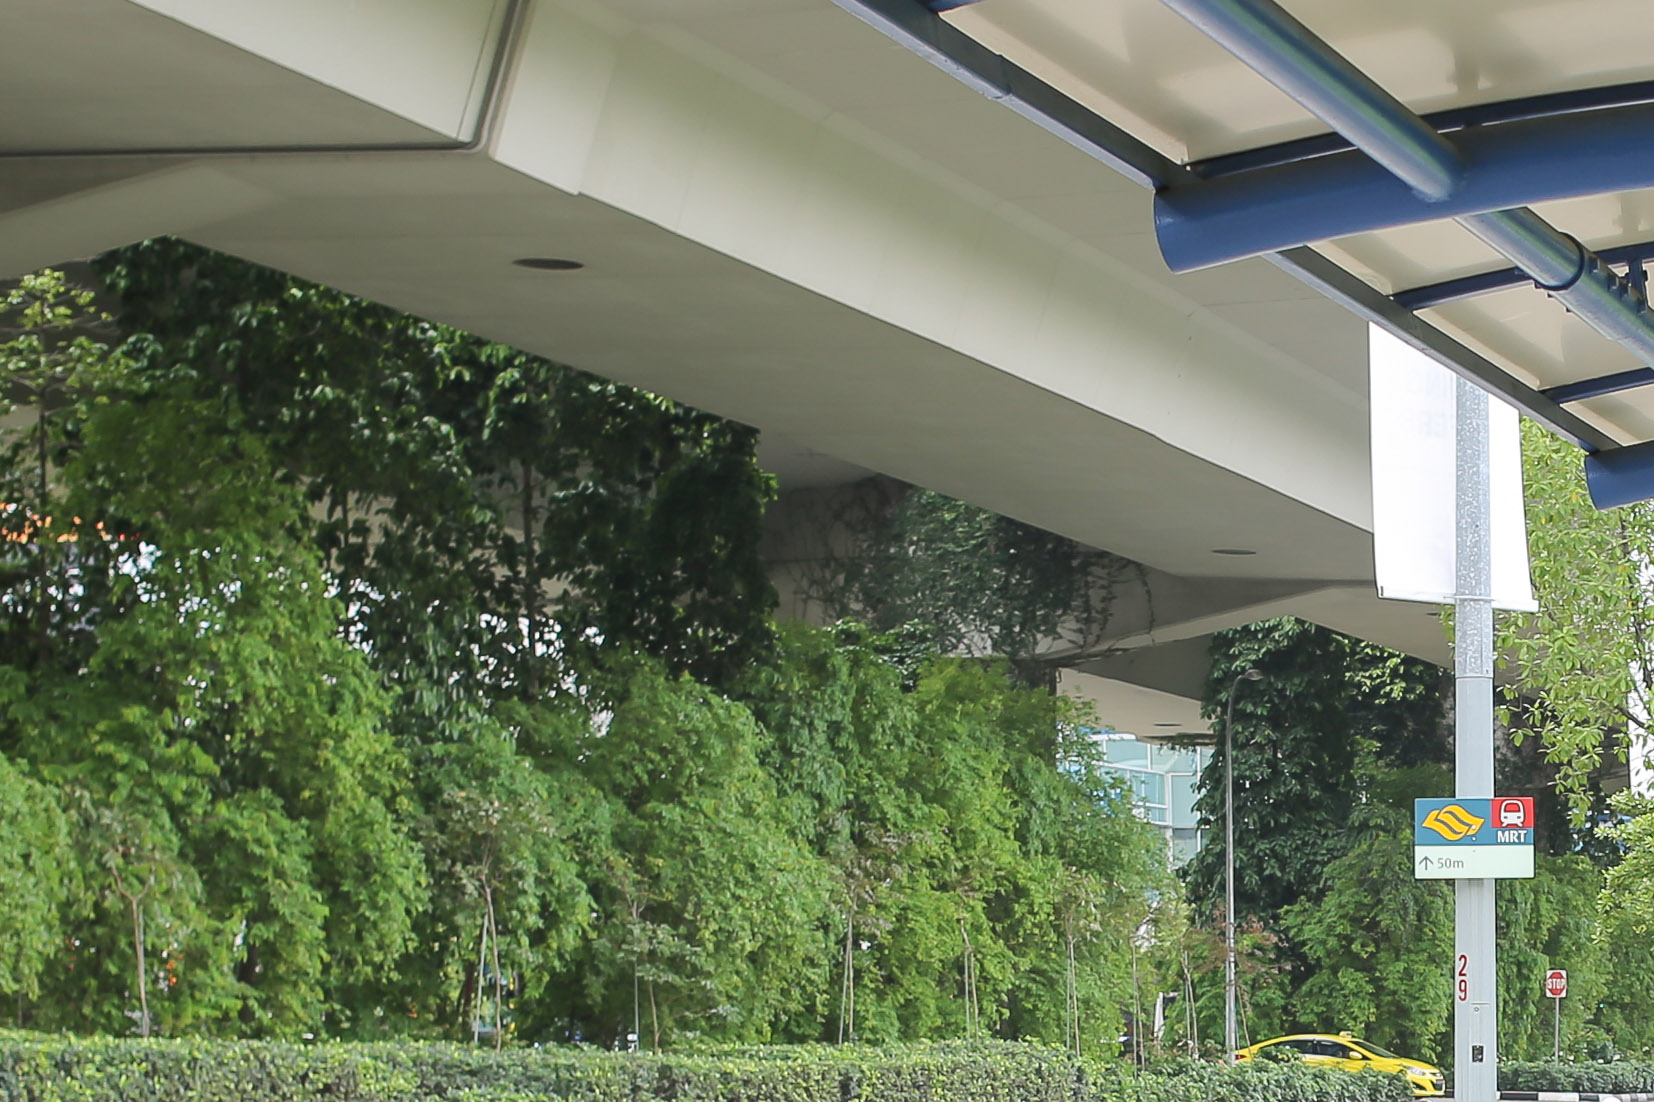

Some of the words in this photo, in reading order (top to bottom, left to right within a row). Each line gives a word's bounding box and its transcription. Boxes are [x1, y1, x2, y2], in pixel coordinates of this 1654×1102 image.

[1497, 830, 1527, 843] MRT
[1437, 857, 1464, 869] 50m
[1458, 954, 1468, 1002] 29
[1547, 978, 1565, 990] STOP
